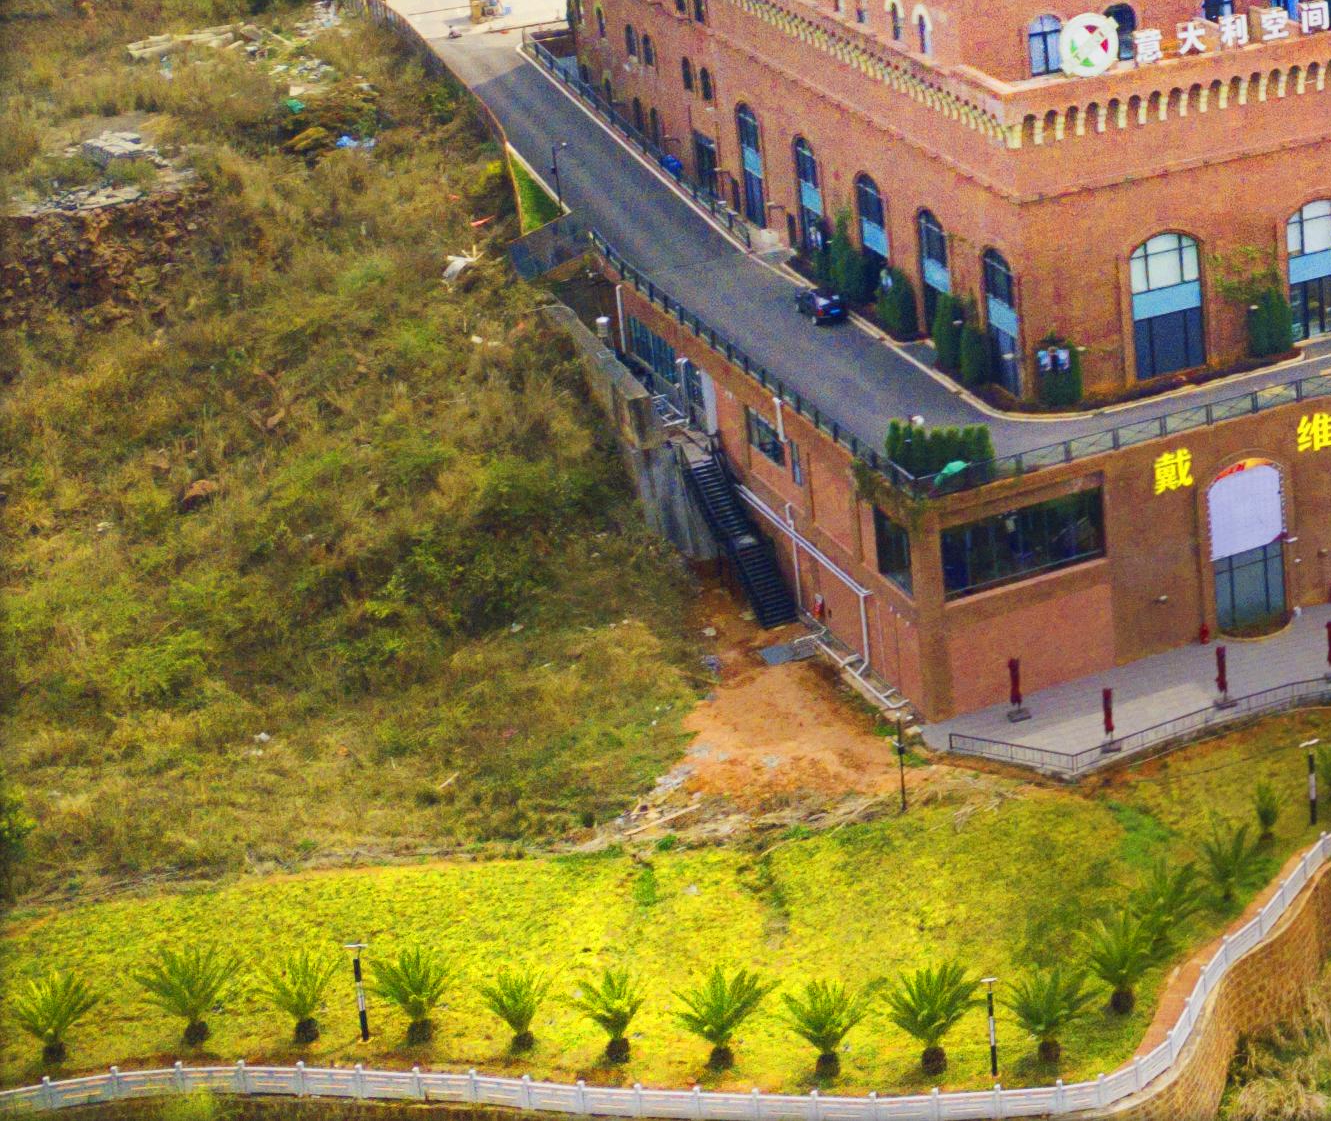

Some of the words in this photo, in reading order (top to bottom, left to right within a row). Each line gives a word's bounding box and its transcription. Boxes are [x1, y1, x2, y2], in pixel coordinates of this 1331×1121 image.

[1133, 0, 1331, 64] 意大利空间
